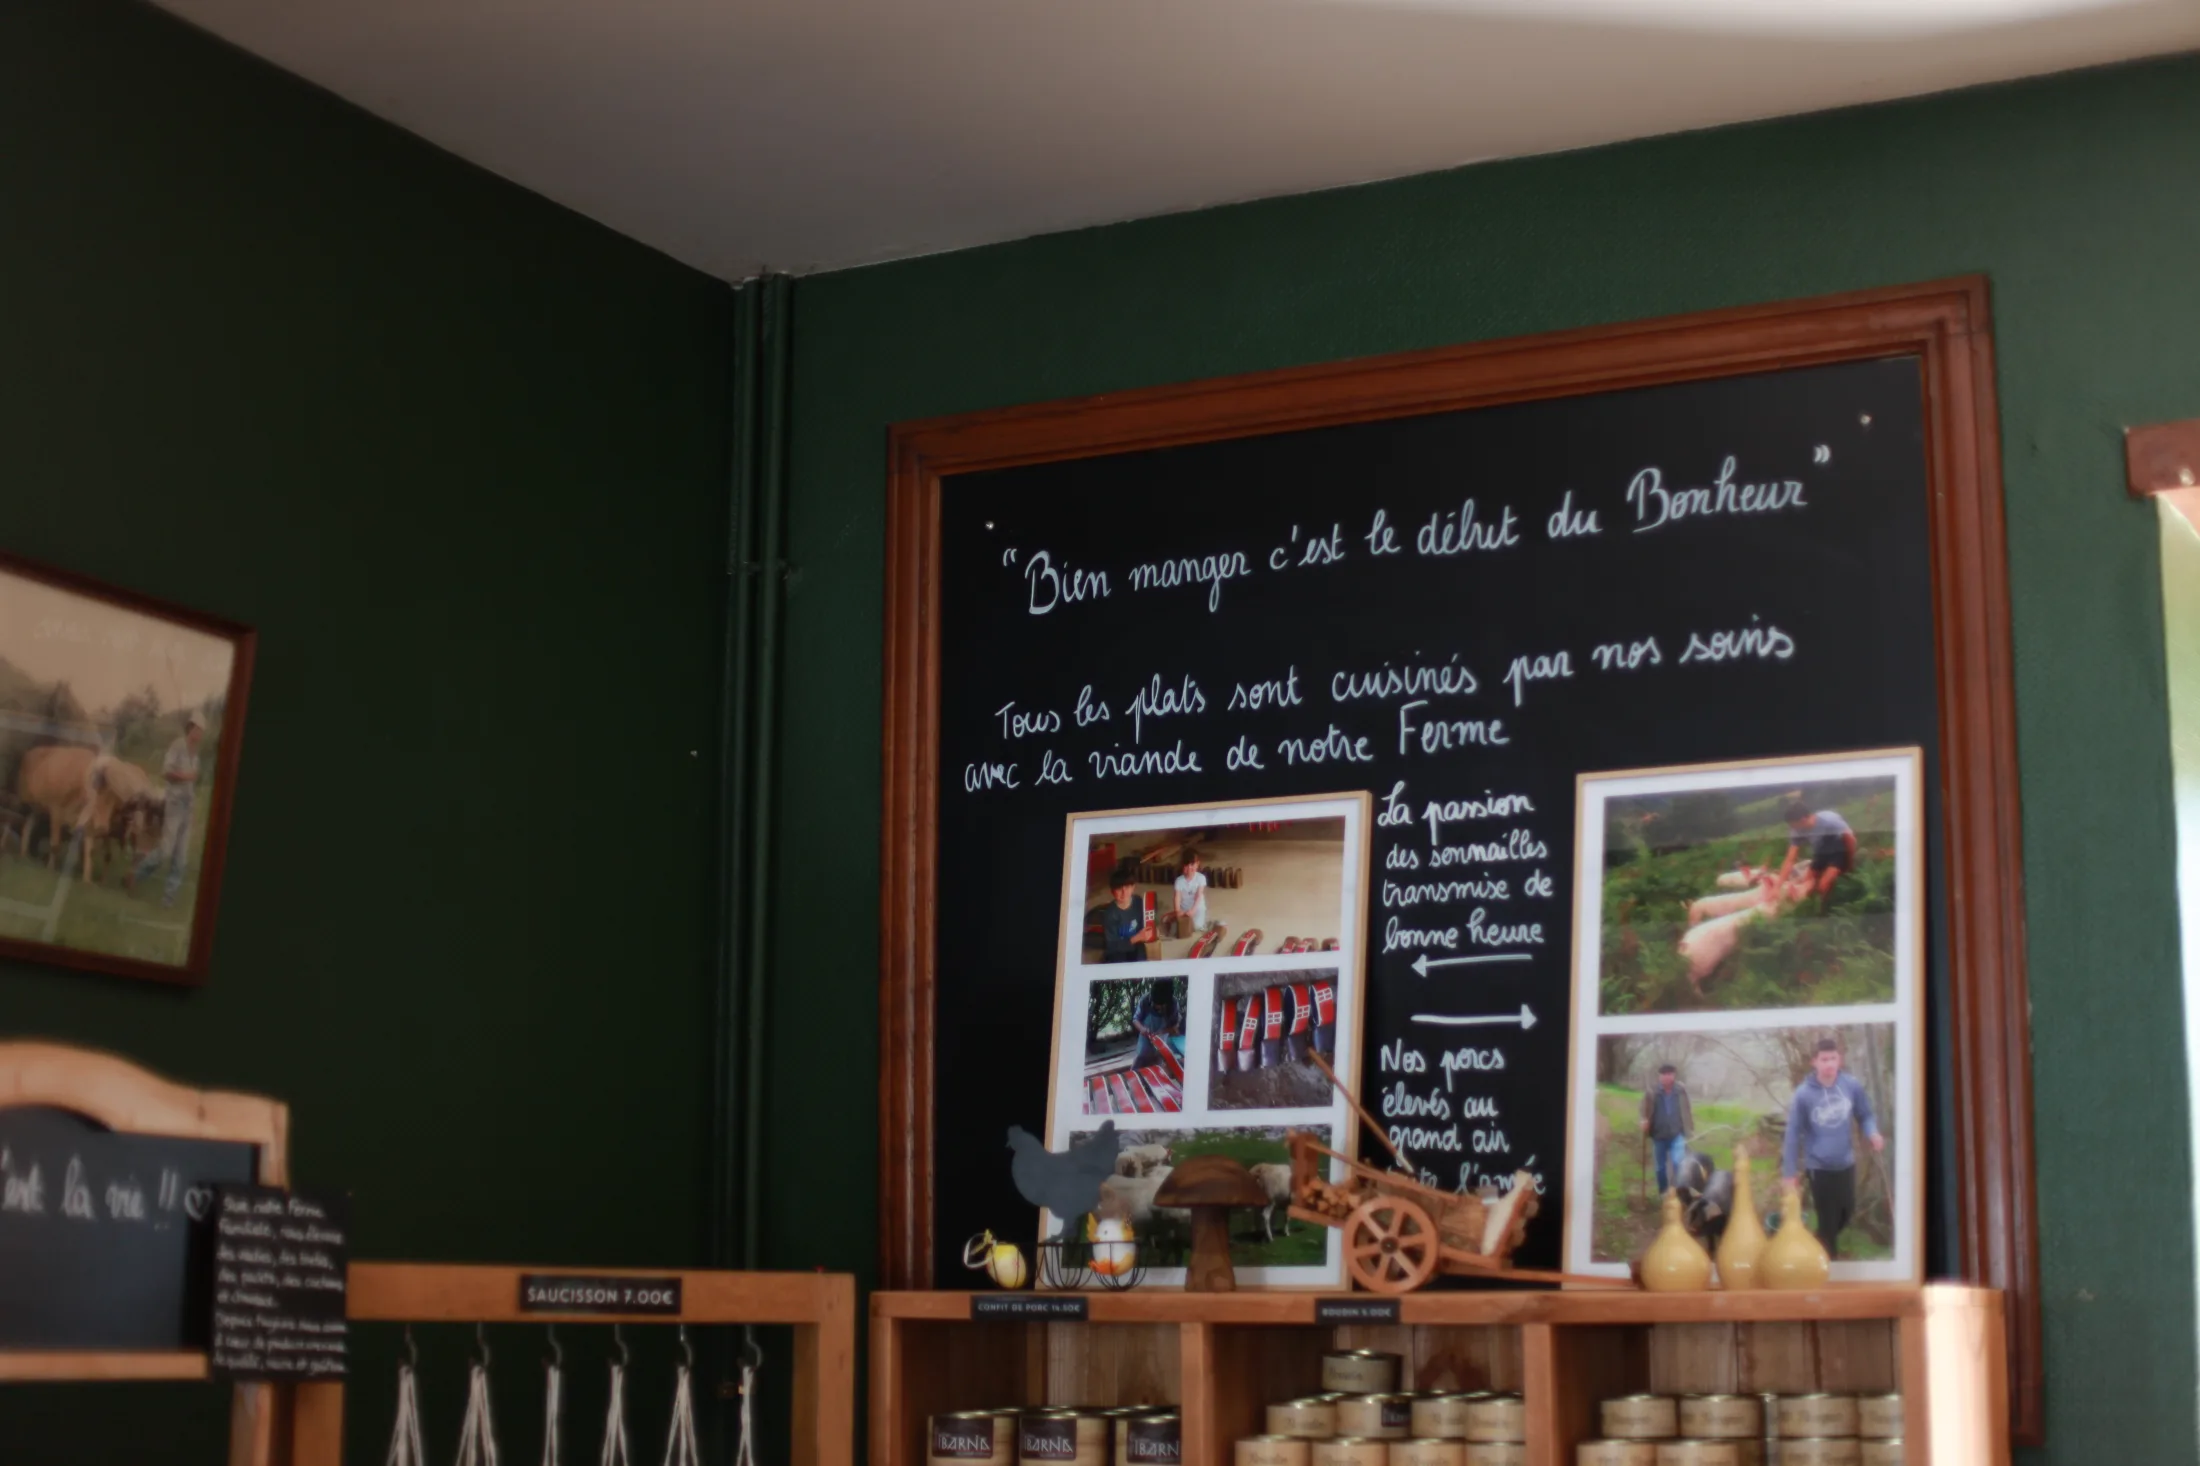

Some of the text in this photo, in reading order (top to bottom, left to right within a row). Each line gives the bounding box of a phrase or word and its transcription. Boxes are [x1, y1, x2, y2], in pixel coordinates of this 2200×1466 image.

[1129, 551, 1251, 613] manger
[1269, 523, 1345, 571] c'est
[1365, 508, 1401, 555] le
[1417, 498, 1520, 555] début
[1547, 490, 1603, 539] du
[994, 613, 1795, 744] Tous les plats sont cuisinés par nos soins
[964, 700, 1510, 793] avec la viande de notre Ferme
[1377, 780, 1535, 846] La passion
[1386, 828, 1548, 870] des sonnailles
[1382, 868, 1554, 908] transmise de
[1382, 906, 1545, 954] bonne heure
[1380, 1038, 1505, 1093] Nos porcs
[1382, 1081, 1499, 1120] élevés au
[1389, 1121, 1510, 1168] grand air
[527, 1286, 674, 1305] SAUCISSON 7.00€
[978, 1303, 1008, 1312] CONFIT
[1025, 1304, 1048, 1312] PORC
[1134, 1438, 1180, 1456] IBARN
